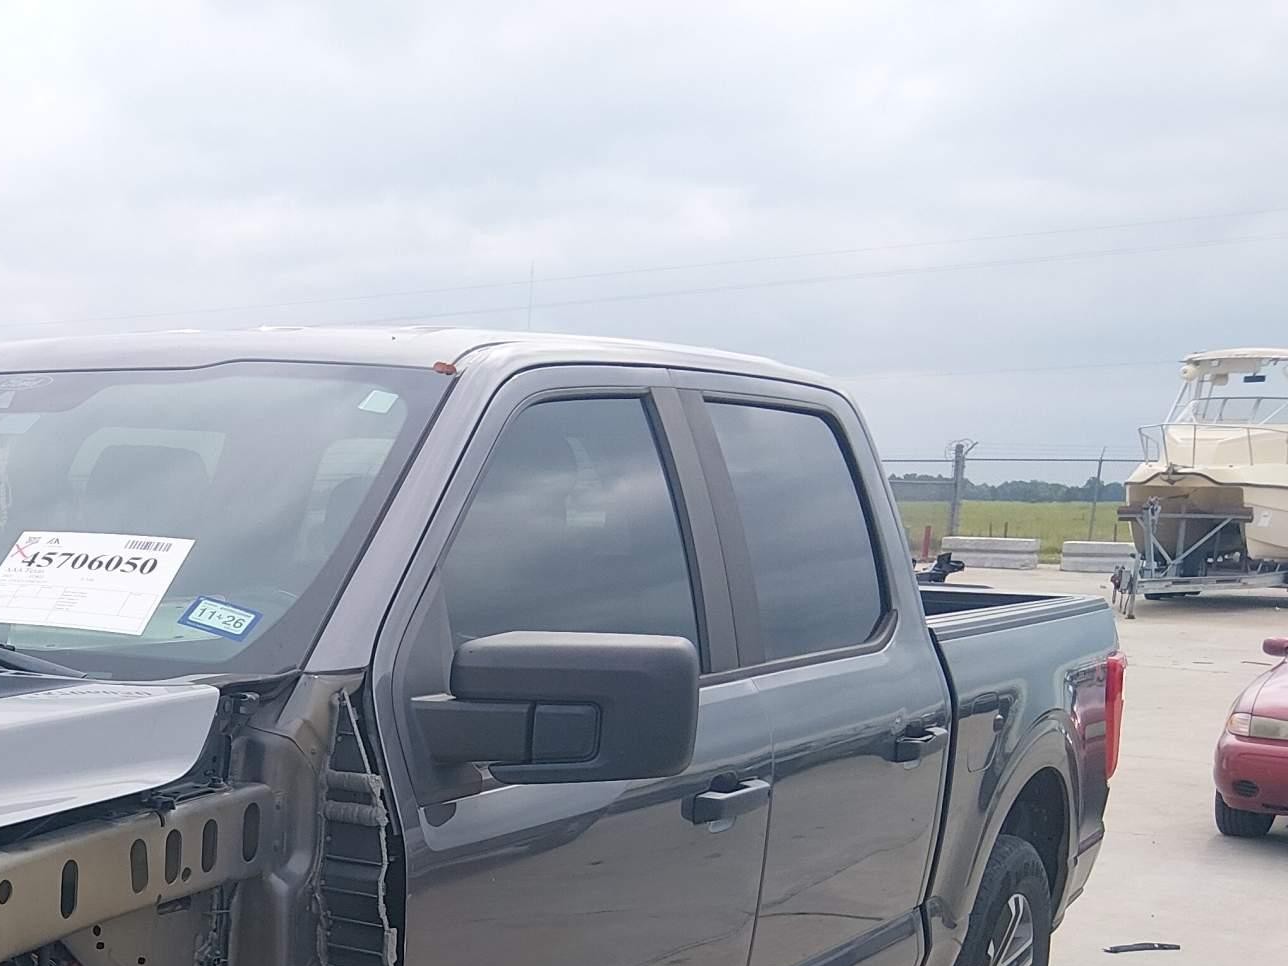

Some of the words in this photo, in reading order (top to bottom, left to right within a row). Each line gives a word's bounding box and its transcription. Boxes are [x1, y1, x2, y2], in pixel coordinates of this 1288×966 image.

[21, 551, 158, 575] 45706050
[198, 607, 217, 620] 11
[222, 615, 246, 629] 26
